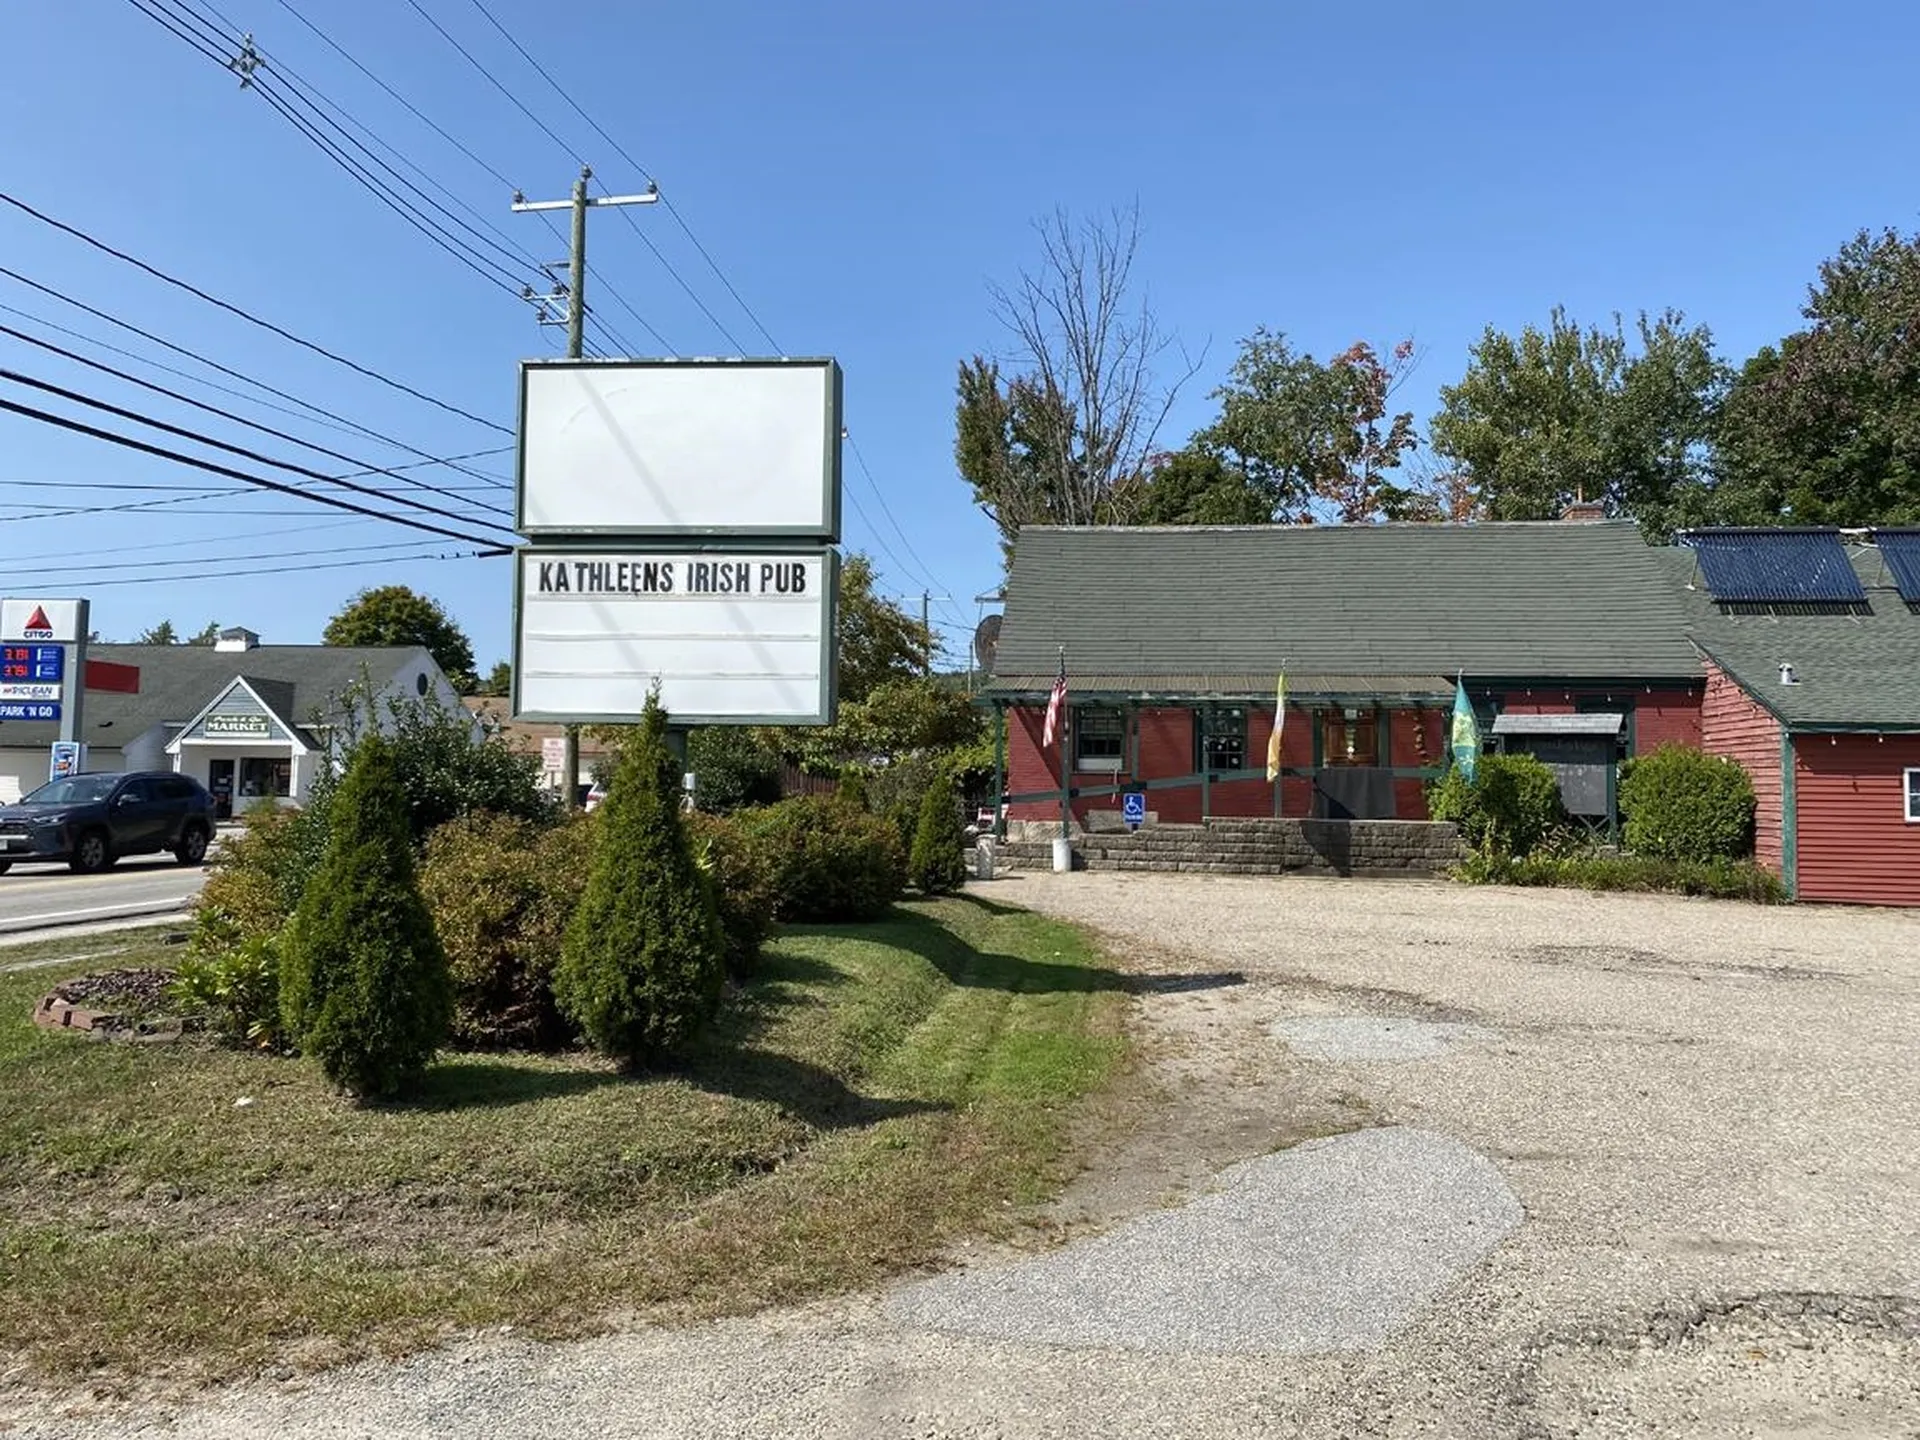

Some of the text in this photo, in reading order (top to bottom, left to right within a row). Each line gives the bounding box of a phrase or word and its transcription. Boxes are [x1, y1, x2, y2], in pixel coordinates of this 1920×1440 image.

[540, 562, 806, 592] KATHLEENS IRISH PUB
[0, 706, 25, 716] PARK
[38, 706, 53, 717] GO
[207, 722, 267, 731] MARKET
